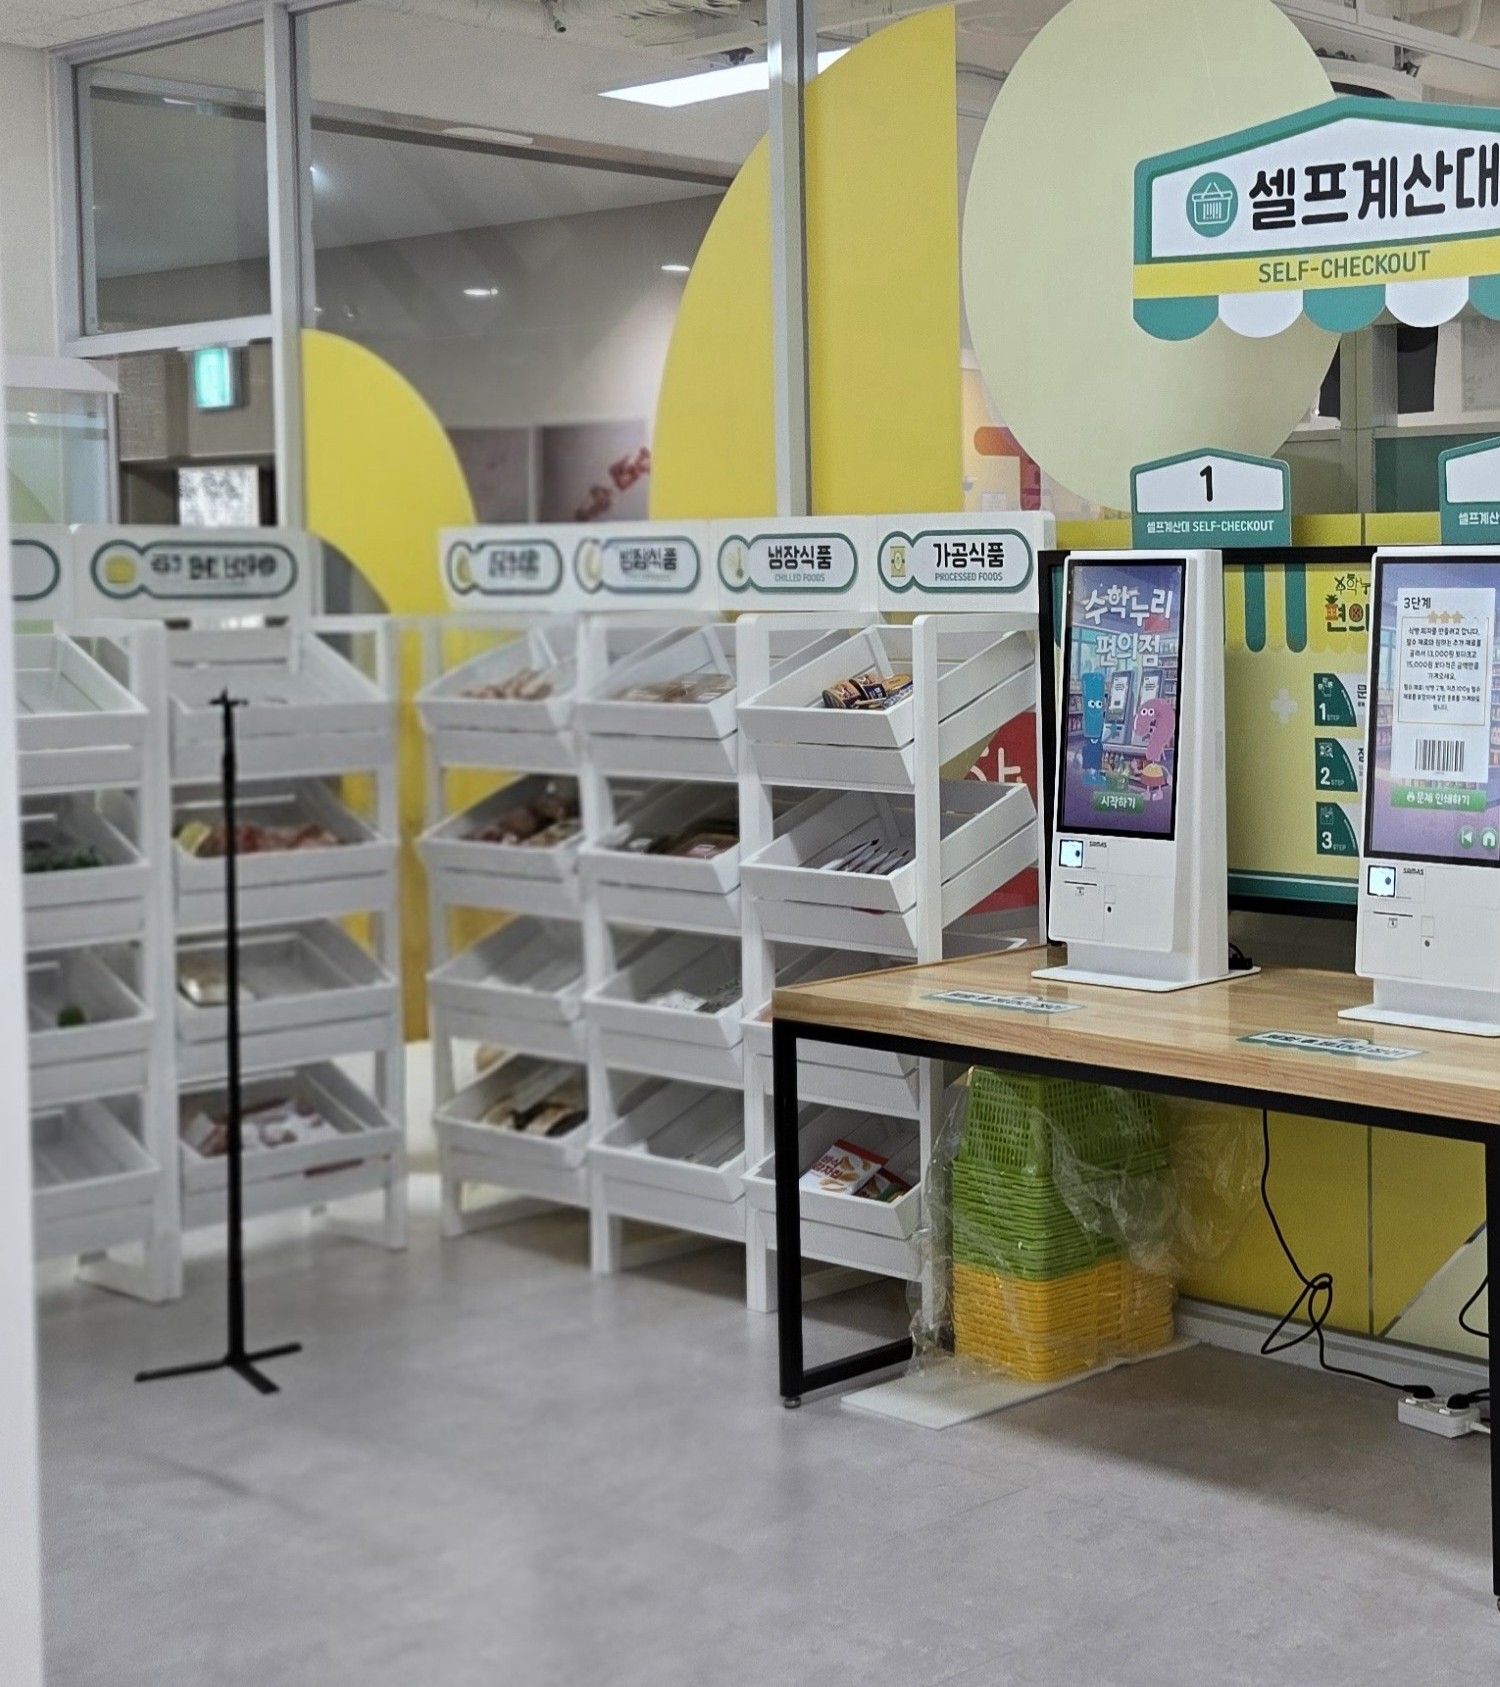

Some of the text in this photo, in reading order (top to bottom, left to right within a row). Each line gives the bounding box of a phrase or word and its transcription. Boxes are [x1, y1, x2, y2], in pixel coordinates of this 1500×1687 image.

[1249, 142, 1500, 231] 셀프계산대
[1258, 250, 1431, 283] SELF-CHECKOUT
[1199, 465, 1214, 502] 1
[1146, 519, 1274, 534] 셀프계산대 SELF-CHECKOUT
[768, 545, 832, 570] 냉장식품
[933, 542, 1004, 568] 가공식품
[774, 573, 826, 582] CHILLED FOODS
[935, 572, 1003, 582] PROCESSED FOODS
[1334, 573, 1371, 595] 수학누
[1085, 585, 1173, 626] 수학누리
[1404, 597, 1431, 609] 3단계
[1325, 602, 1370, 632] 편의
[1096, 633, 1160, 667] 편의점
[1318, 702, 1327, 721] 1
[1320, 766, 1331, 786] 2
[1100, 797, 1136, 810] 시작하기
[1416, 792, 1470, 806] 문제 인쇄하기
[1321, 831, 1333, 850] 3
